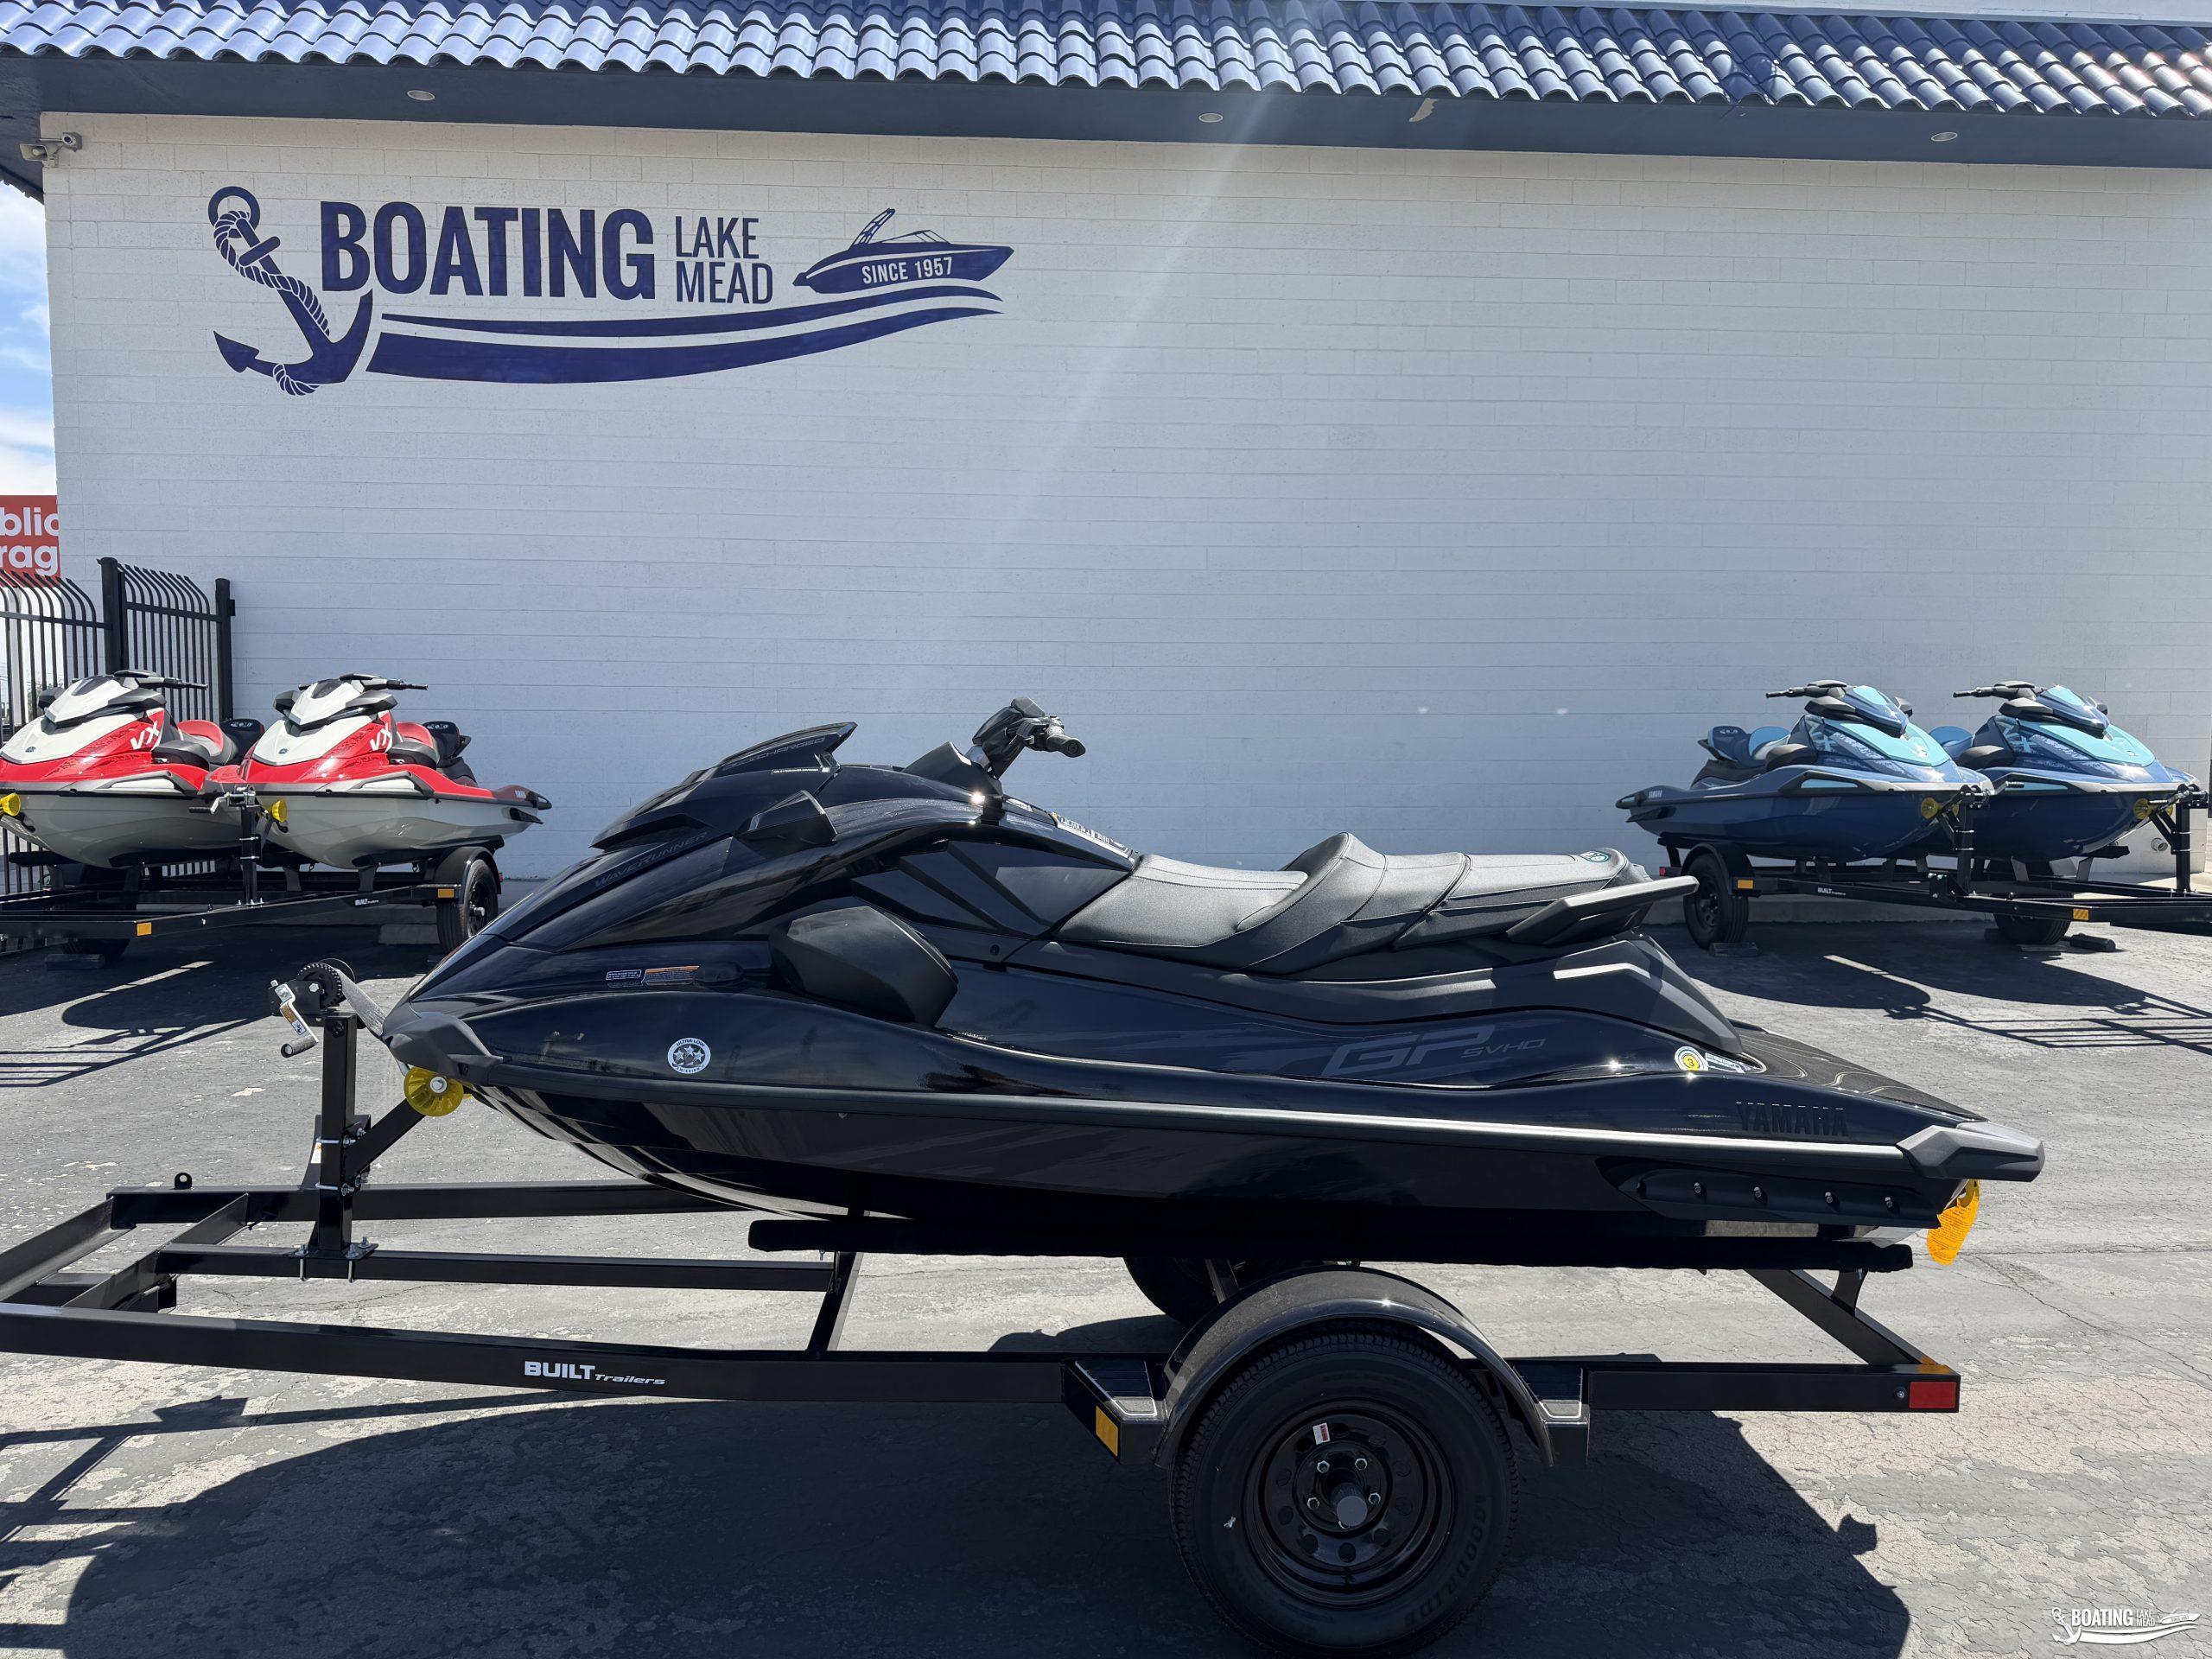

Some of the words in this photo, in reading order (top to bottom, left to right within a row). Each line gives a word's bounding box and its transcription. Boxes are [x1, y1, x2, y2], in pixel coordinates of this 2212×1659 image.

[321, 200, 656, 301] BOATING
[676, 216, 760, 259] LAKE
[676, 261, 773, 305] MEAD
[861, 261, 909, 284] SINCE
[915, 257, 952, 278] 1957
[130, 721, 160, 750] VX
[370, 722, 391, 751] VX
[1321, 1024, 1496, 1077] GP
[1460, 1039, 1547, 1058] SVHO
[1736, 1101, 1849, 1137] YAMAHA
[524, 1360, 595, 1380] BUILT
[595, 1374, 665, 1385] Trailers
